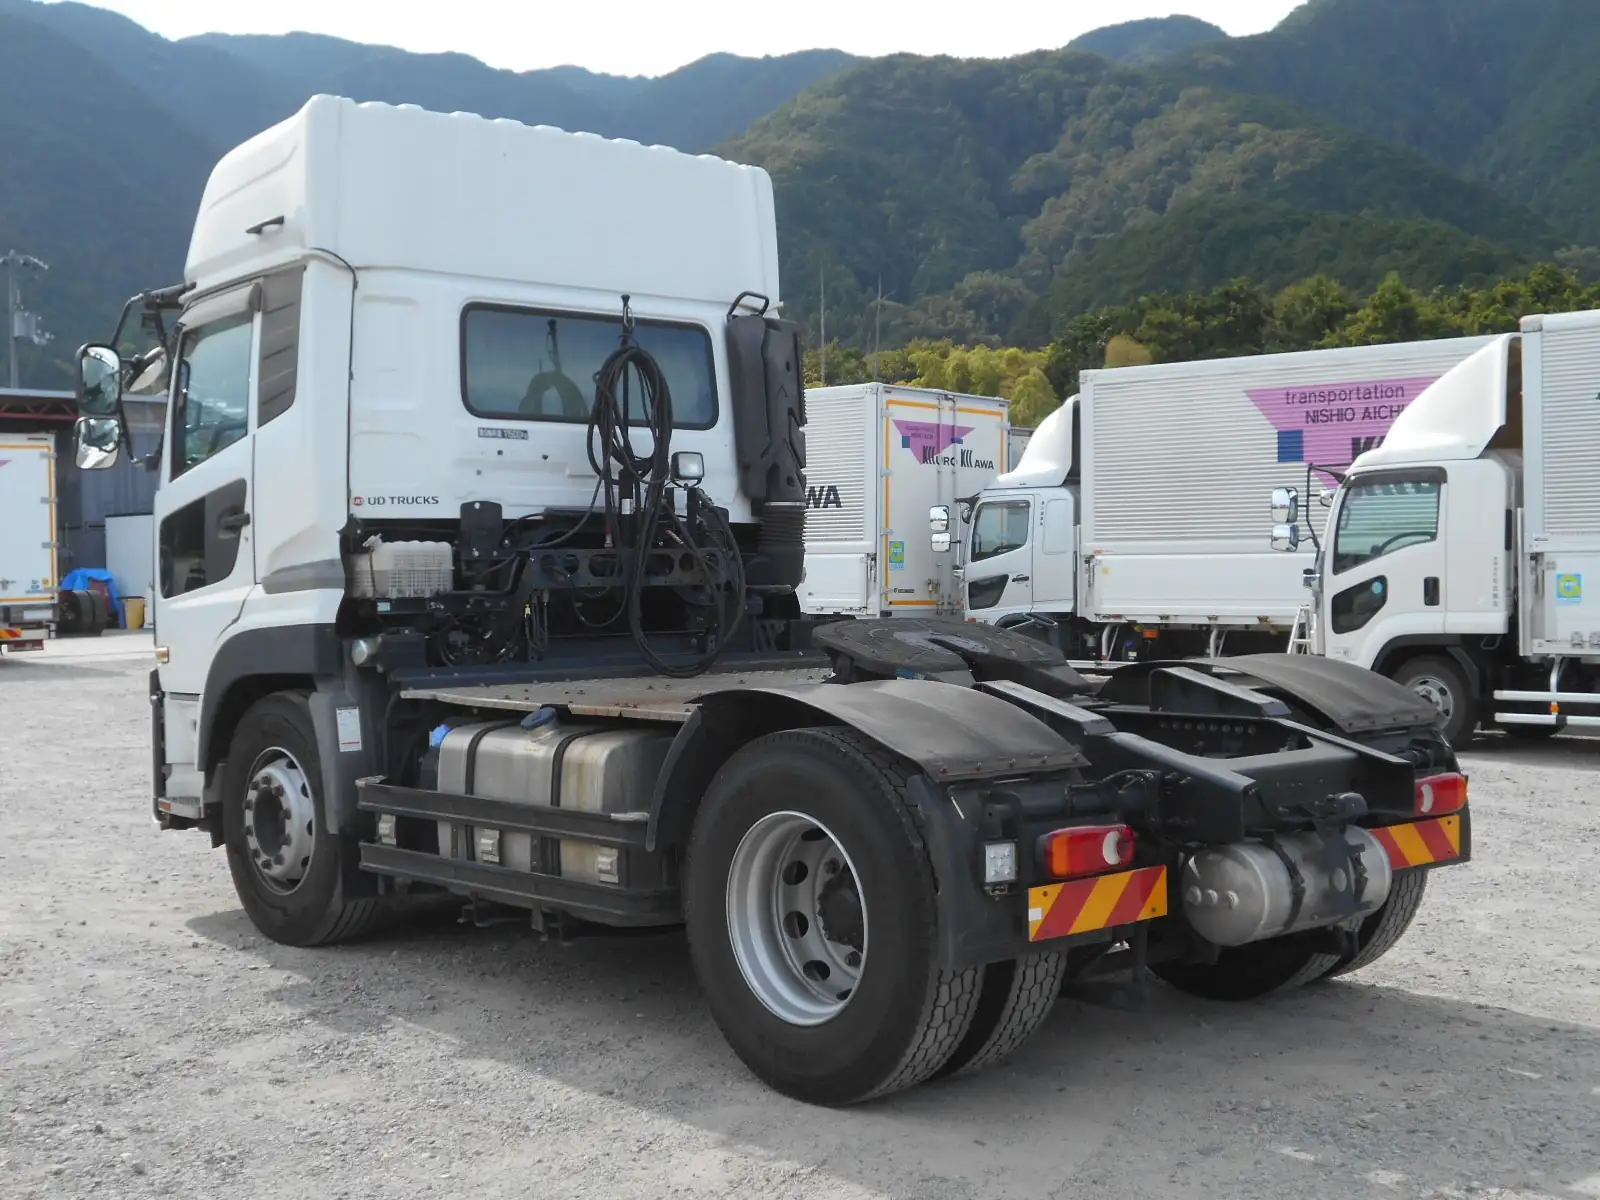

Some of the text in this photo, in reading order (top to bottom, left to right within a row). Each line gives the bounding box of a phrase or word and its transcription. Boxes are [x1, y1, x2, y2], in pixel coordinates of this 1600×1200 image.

[1285, 384, 1405, 406] transportation
[1305, 407, 1356, 424] NISHIO
[367, 495, 440, 506] UD TRUCKS
